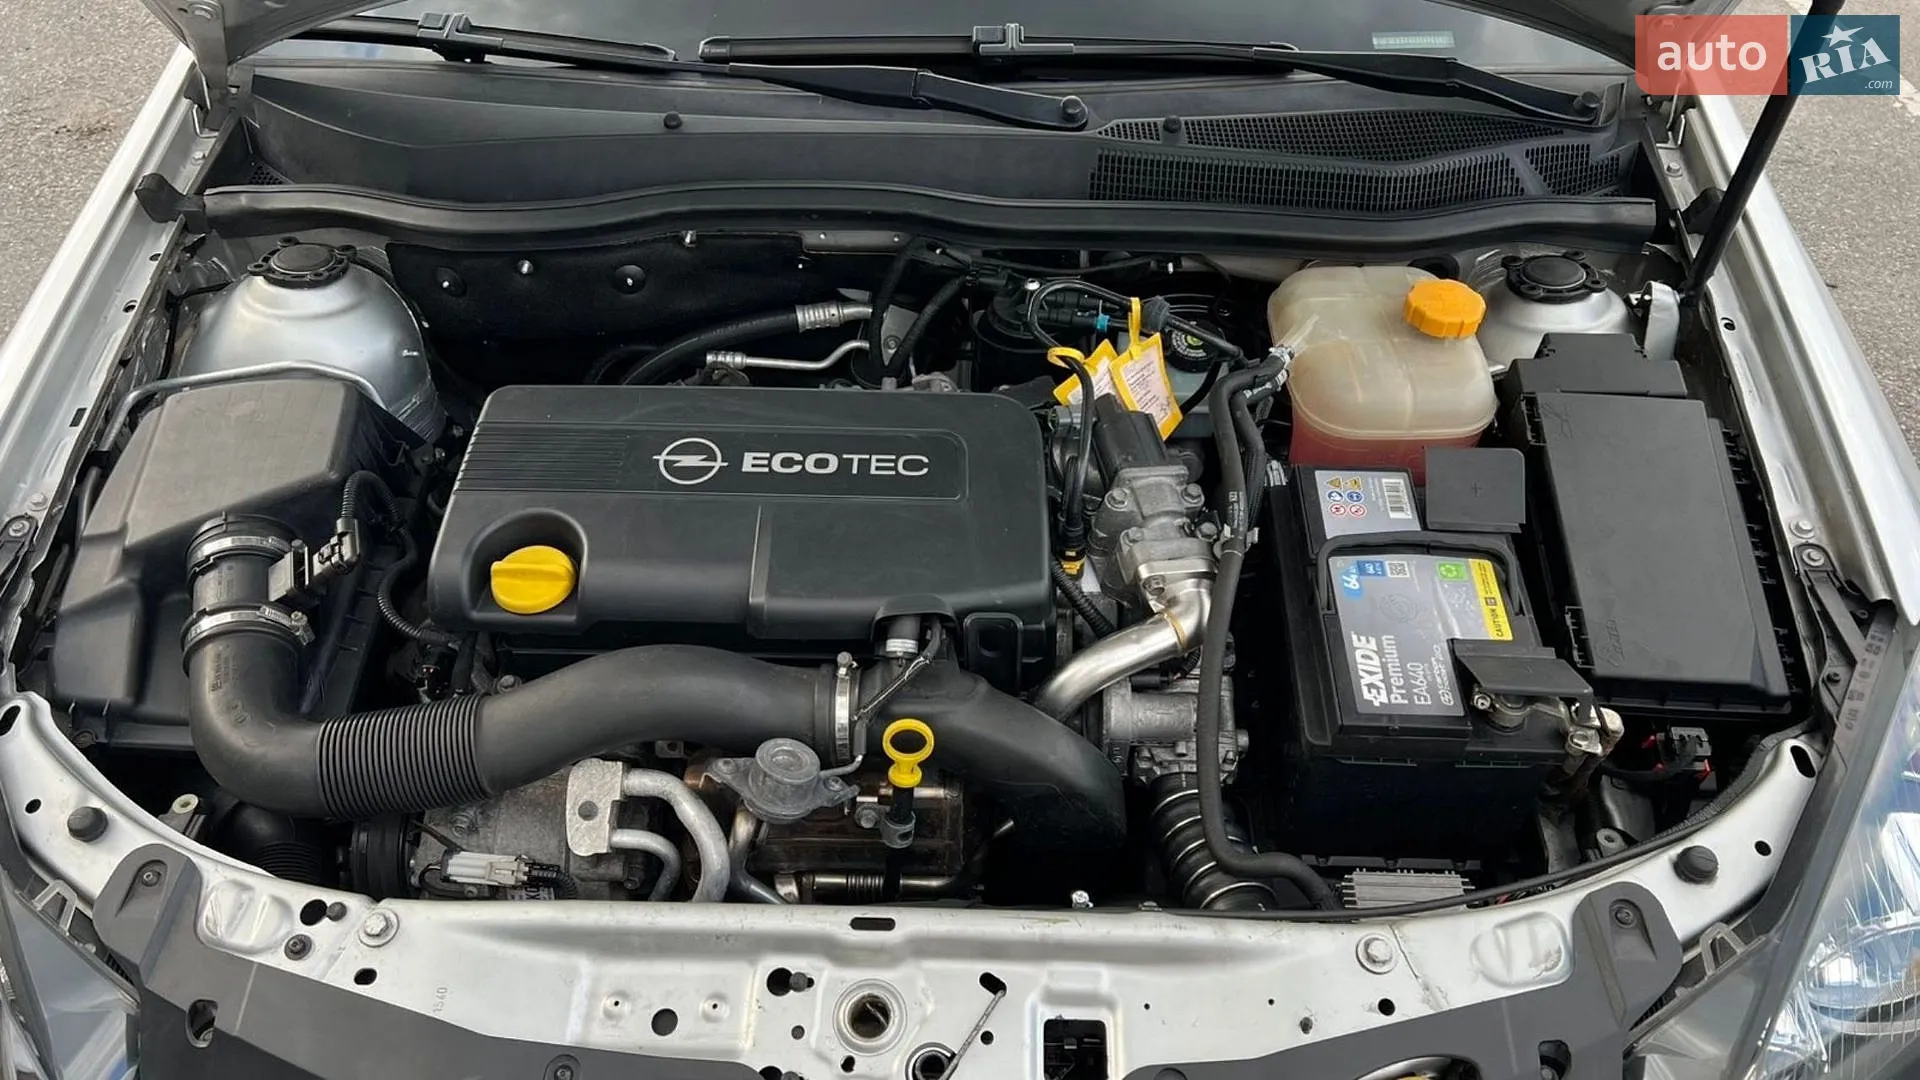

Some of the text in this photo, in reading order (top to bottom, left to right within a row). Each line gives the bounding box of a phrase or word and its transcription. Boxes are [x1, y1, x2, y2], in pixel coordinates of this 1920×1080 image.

[741, 451, 930, 476] ECOTEC
[1488, 608, 1504, 637] CAUTION
[1351, 631, 1389, 707] EXIDE
[1381, 634, 1408, 704] Premium
[1407, 661, 1432, 705] EA640
